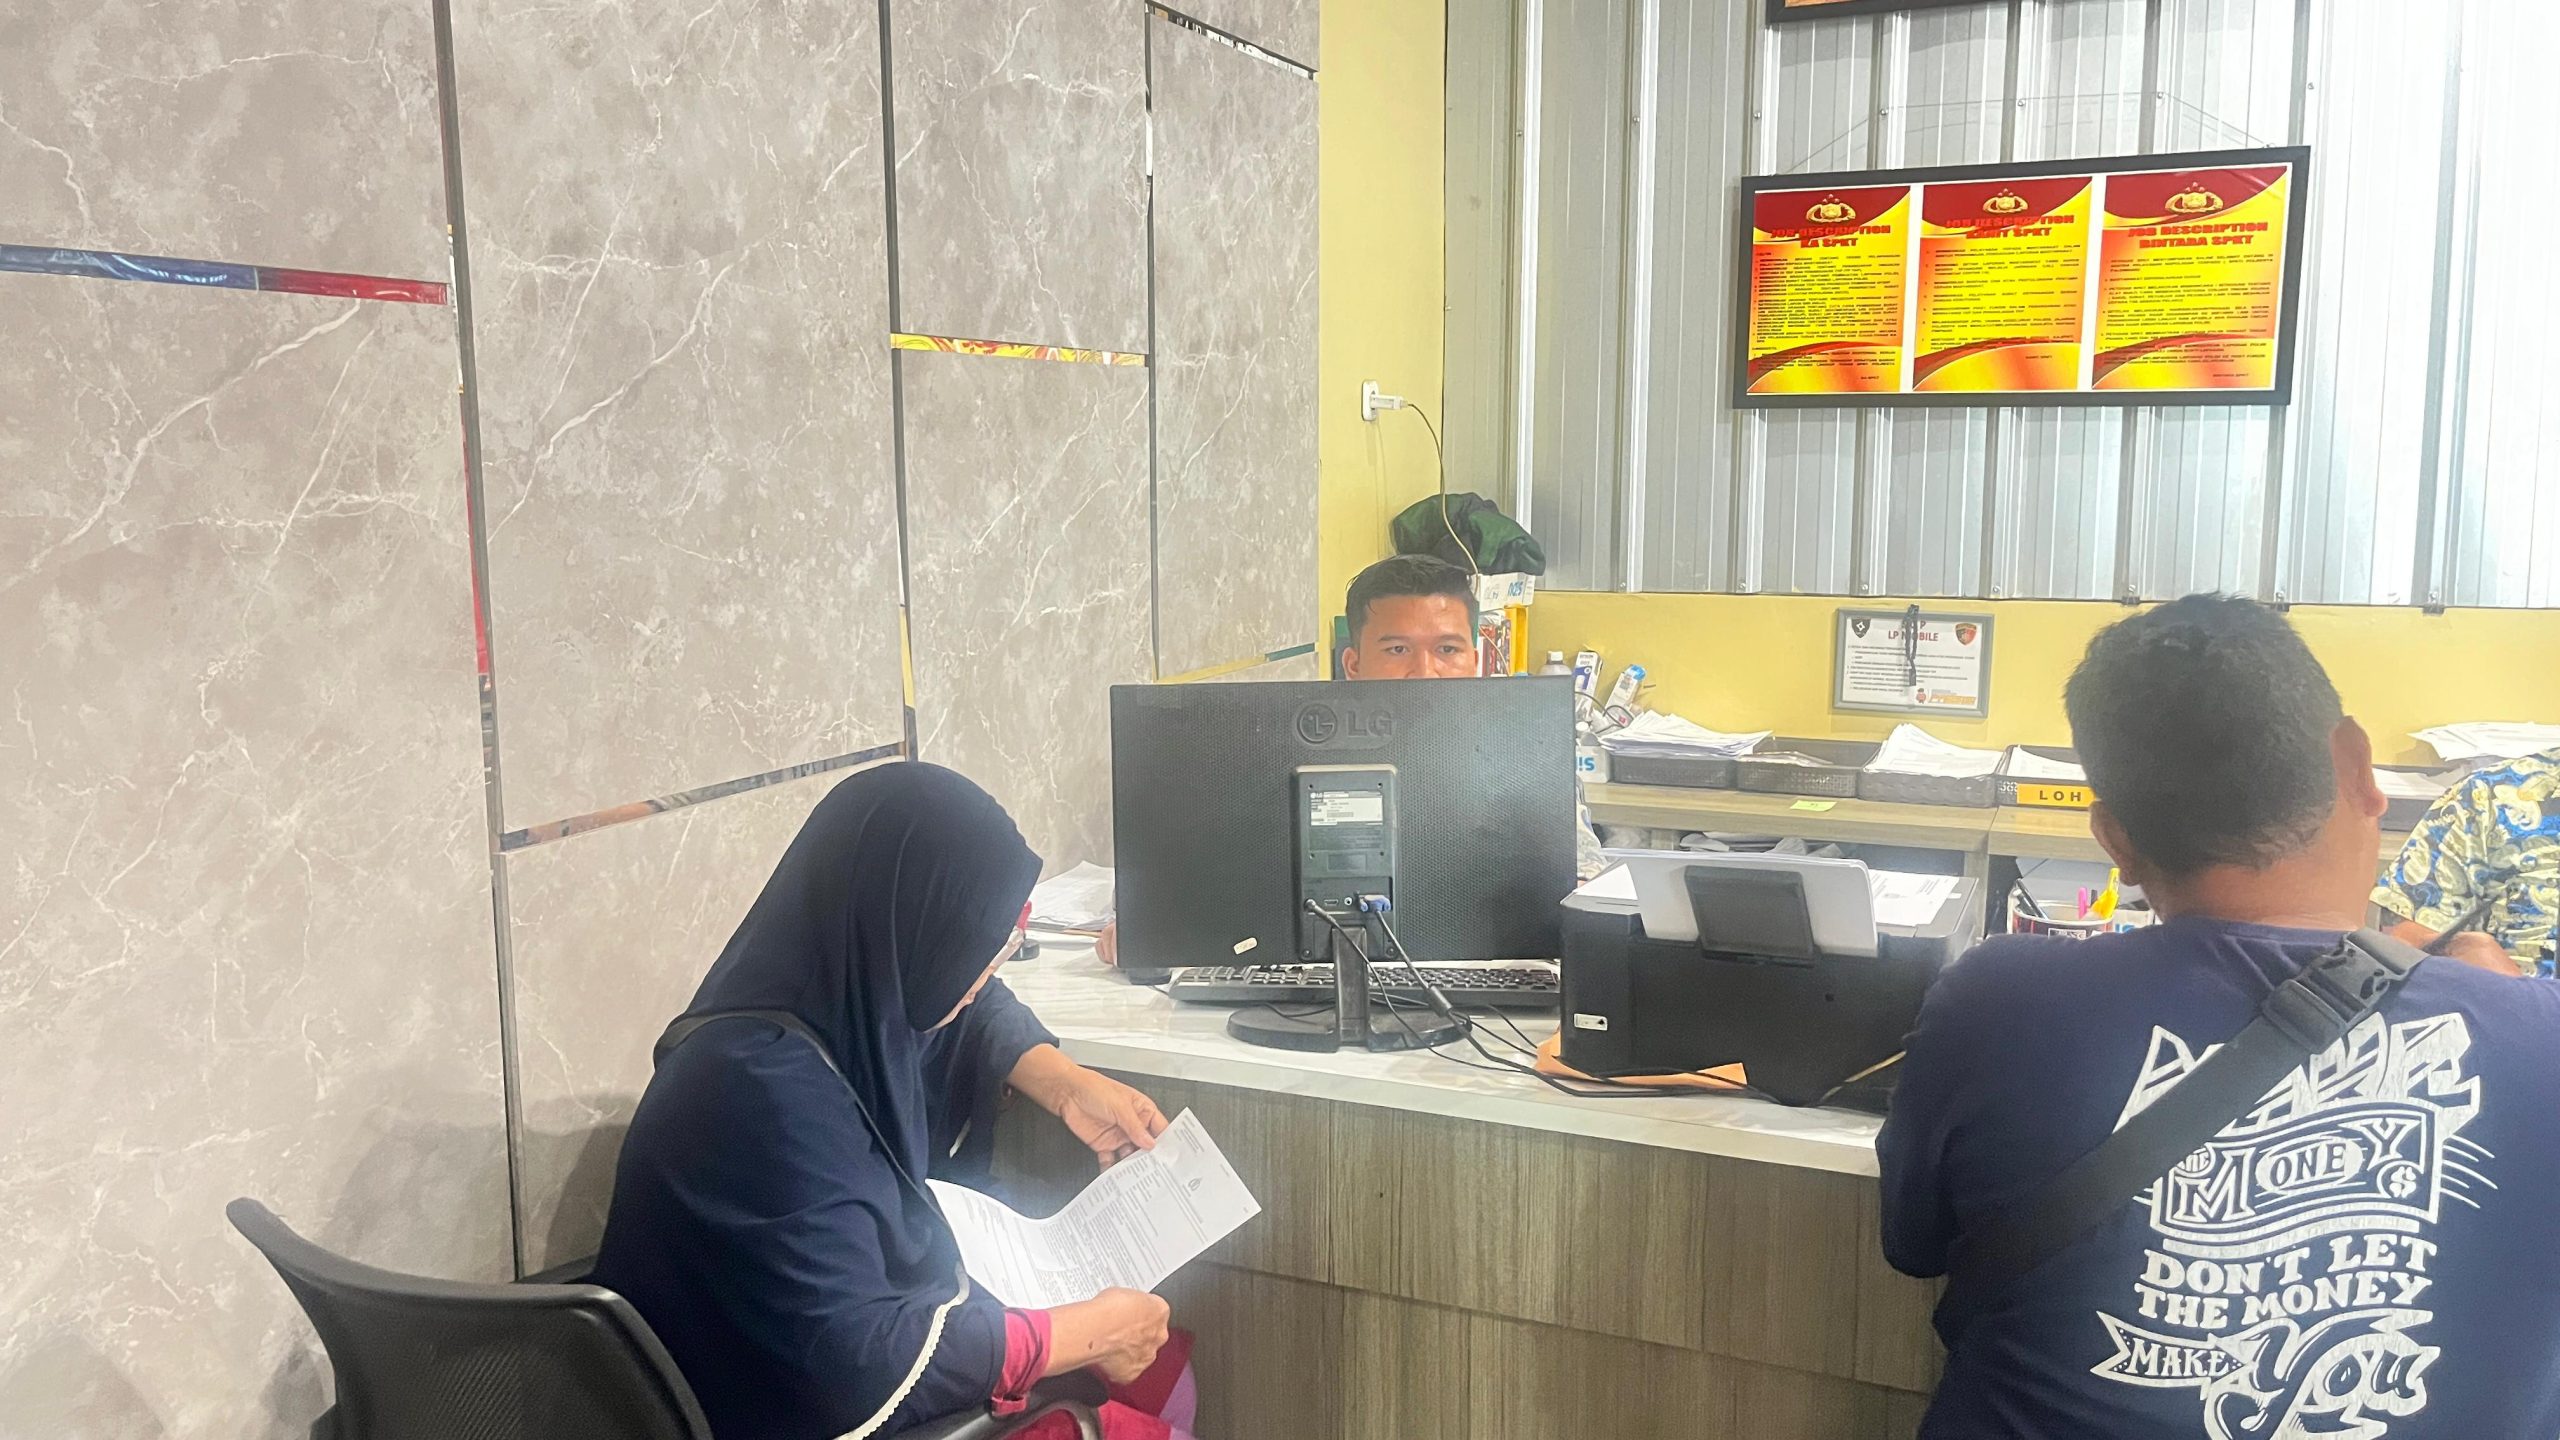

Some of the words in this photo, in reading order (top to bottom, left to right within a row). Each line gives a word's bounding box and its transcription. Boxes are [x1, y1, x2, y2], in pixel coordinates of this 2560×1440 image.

[1975, 215, 2075, 228] DESCRIPTION
[2128, 226, 2157, 237] JOB
[2160, 221, 2269, 235] DESCRIPTION
[1799, 225, 1891, 239] DESCRIPTION
[2139, 237, 2208, 248] BINTARA
[2211, 235, 2254, 246] SPKT
[1888, 630, 1899, 640] LP
[1901, 631, 1939, 641] BILE
[1346, 711, 1392, 737] LG
[2139, 1246, 2310, 1295] DON'T
[2327, 1233, 2437, 1273] LET
[2134, 1282, 2230, 1329] THE
[2241, 1271, 2433, 1325] MONEY
[2125, 1337, 2230, 1378] MAKE
